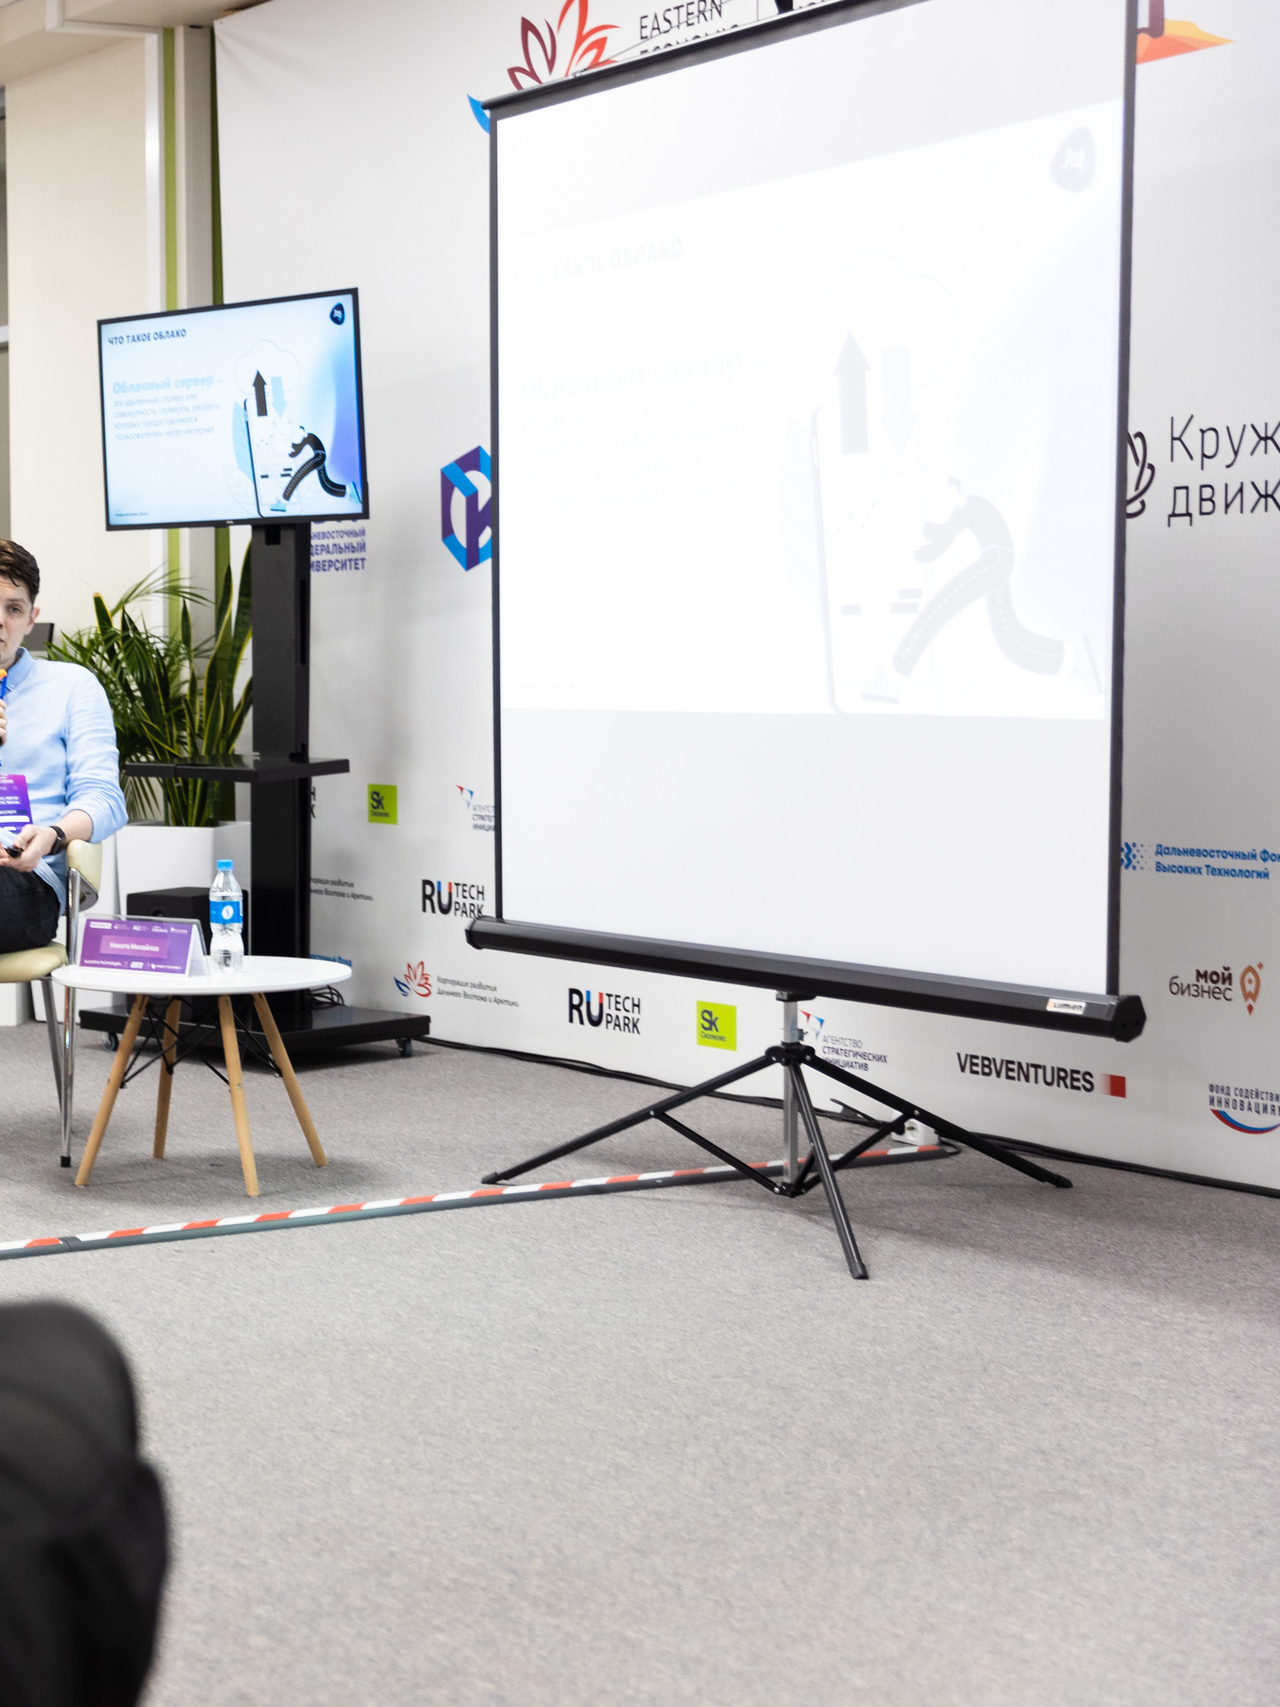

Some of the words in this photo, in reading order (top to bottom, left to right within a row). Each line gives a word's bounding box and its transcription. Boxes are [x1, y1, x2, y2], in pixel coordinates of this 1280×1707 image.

[639, 0, 723, 40] EASTERN
[108, 336, 124, 346] ЧТО
[126, 332, 152, 344] ТАКОЕ
[152, 328, 187, 342] ОБЛАКО
[1170, 414, 1280, 470] Круж
[1167, 479, 1280, 528] движ
[1155, 844, 1257, 861] Дальневосточный
[1155, 862, 1203, 876] Высоких
[1205, 864, 1270, 880] Технологий
[422, 879, 453, 916] RU
[454, 882, 485, 901] TECH
[454, 901, 485, 919] PARK
[1195, 966, 1233, 986] мой
[1169, 975, 1233, 1002] бизнес
[568, 987, 604, 1027] RU
[606, 993, 641, 1015] TECH
[605, 1014, 640, 1035] PARK
[700, 1009, 719, 1033] Sk
[956, 1052, 1095, 1093] VEBVENTURES
[1208, 1083, 1231, 1097] ФОНД
[1234, 1086, 1280, 1103] СОДЕЙСТВИ
